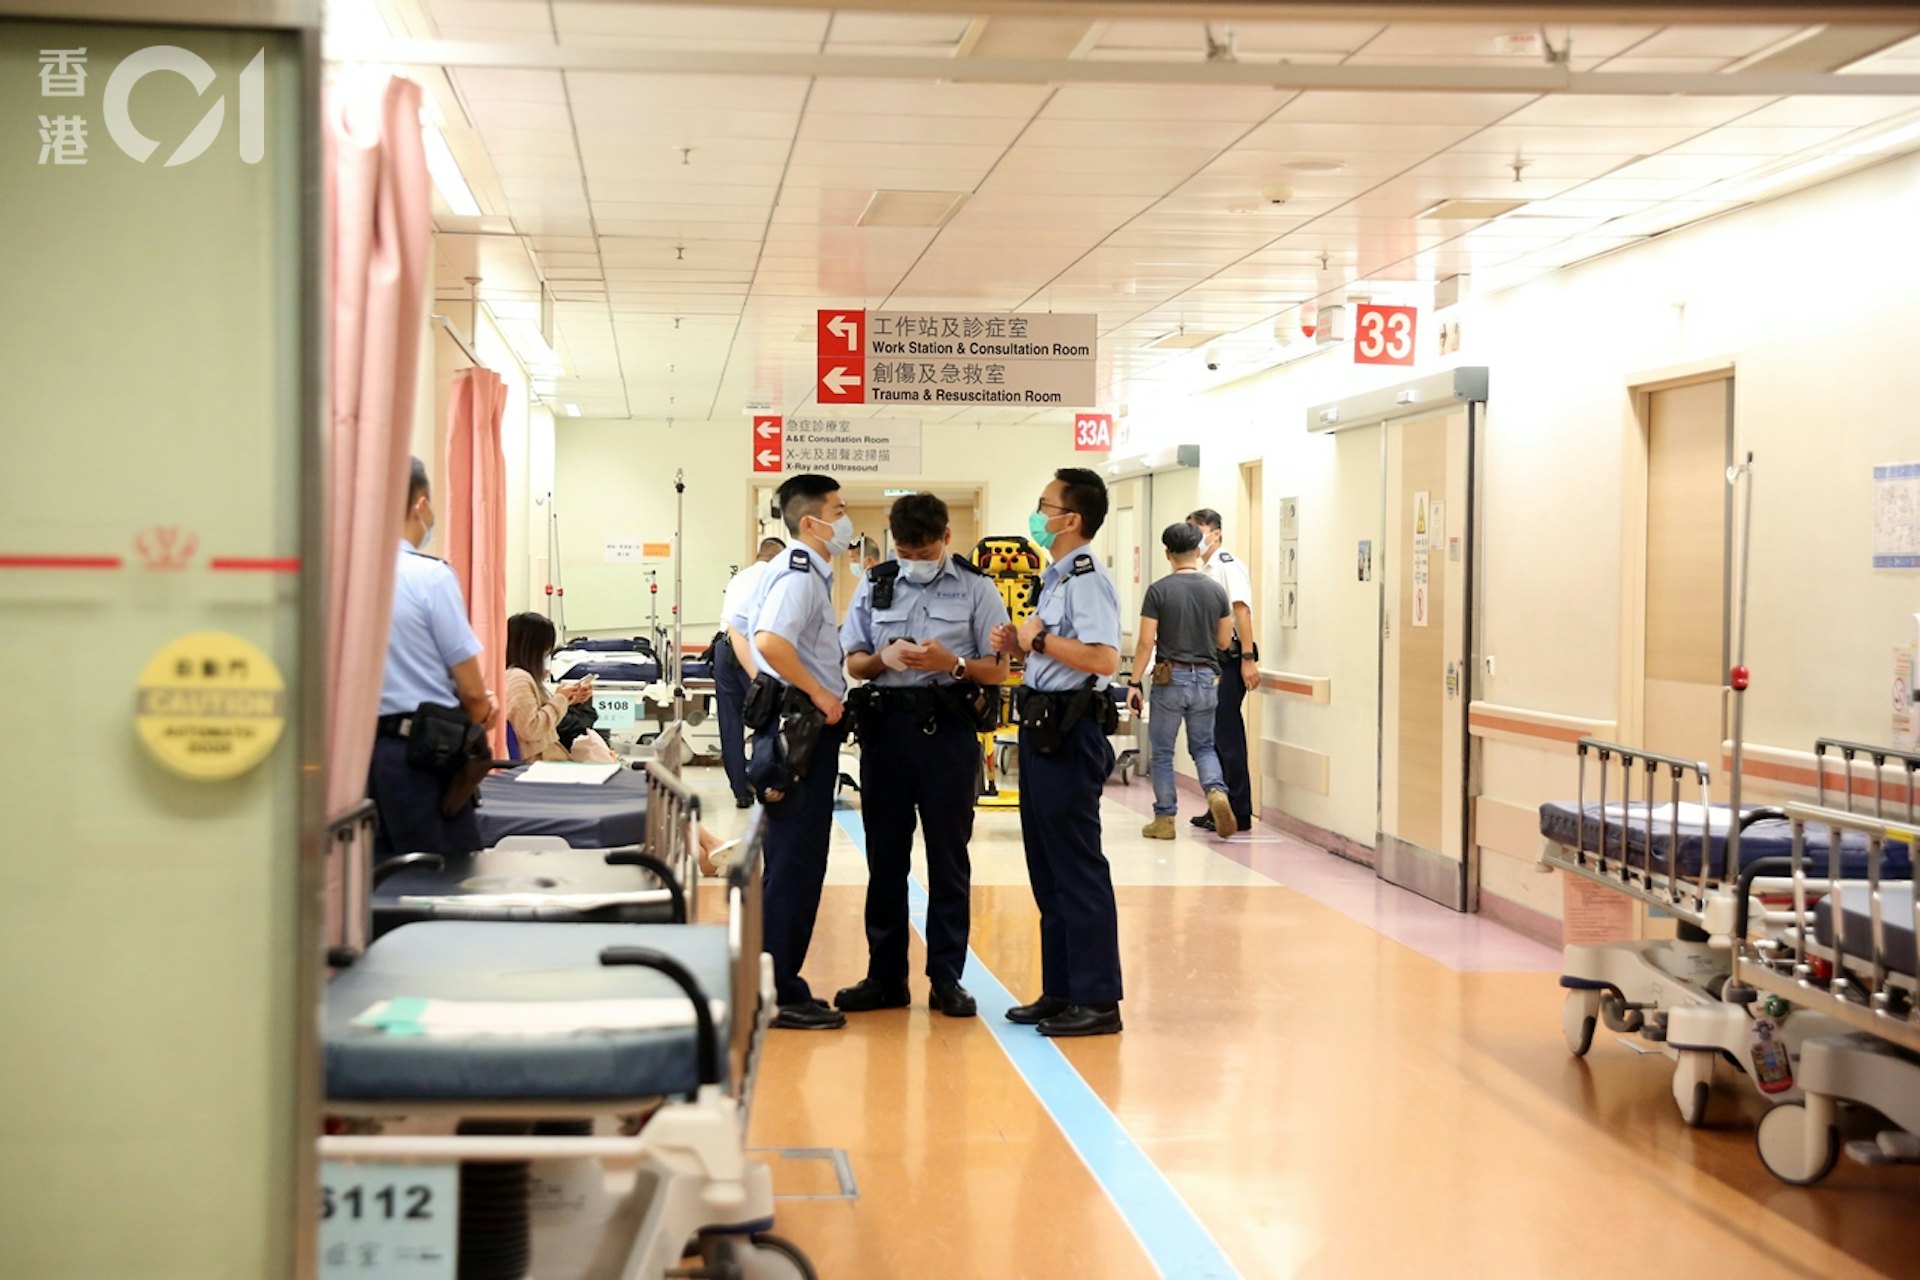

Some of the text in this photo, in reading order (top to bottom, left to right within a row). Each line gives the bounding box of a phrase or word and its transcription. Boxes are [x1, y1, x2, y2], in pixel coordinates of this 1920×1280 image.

[873, 316, 1028, 338] 工作站及診症室
[1359, 311, 1412, 359] 33
[872, 341, 1089, 355] Work Station & Consultation Room
[873, 362, 1005, 384] 創傷及急救室
[872, 388, 1061, 402] Trauma & Resuscitation Room
[786, 419, 850, 432] 急症診療室
[1077, 419, 1110, 446] 33A
[808, 435, 862, 443] Consultation
[786, 463, 811, 471] X-Ray
[831, 464, 878, 472] Ultrasound
[598, 701, 629, 710] S108
